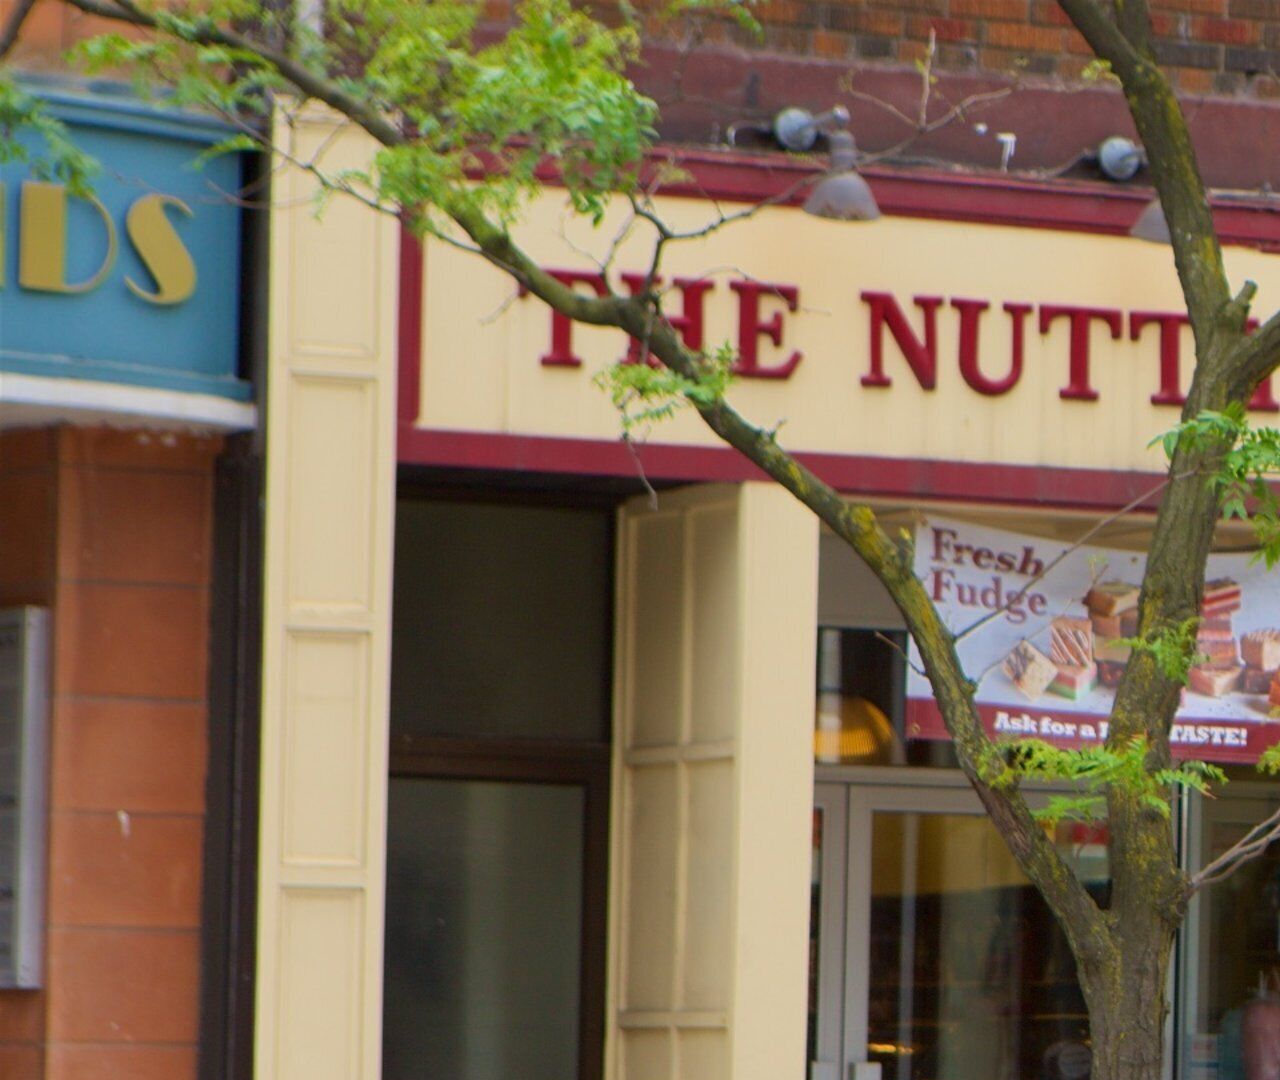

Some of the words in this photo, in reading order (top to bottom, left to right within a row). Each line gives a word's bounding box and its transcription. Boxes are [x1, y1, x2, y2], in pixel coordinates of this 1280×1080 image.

[0, 180, 197, 305] DS
[519, 268, 804, 380] THE
[930, 527, 1045, 577] Fresh
[930, 569, 1047, 624] Fudge
[994, 711, 1037, 734] Ask
[1039, 717, 1077, 739] for
[1079, 724, 1097, 740] a
